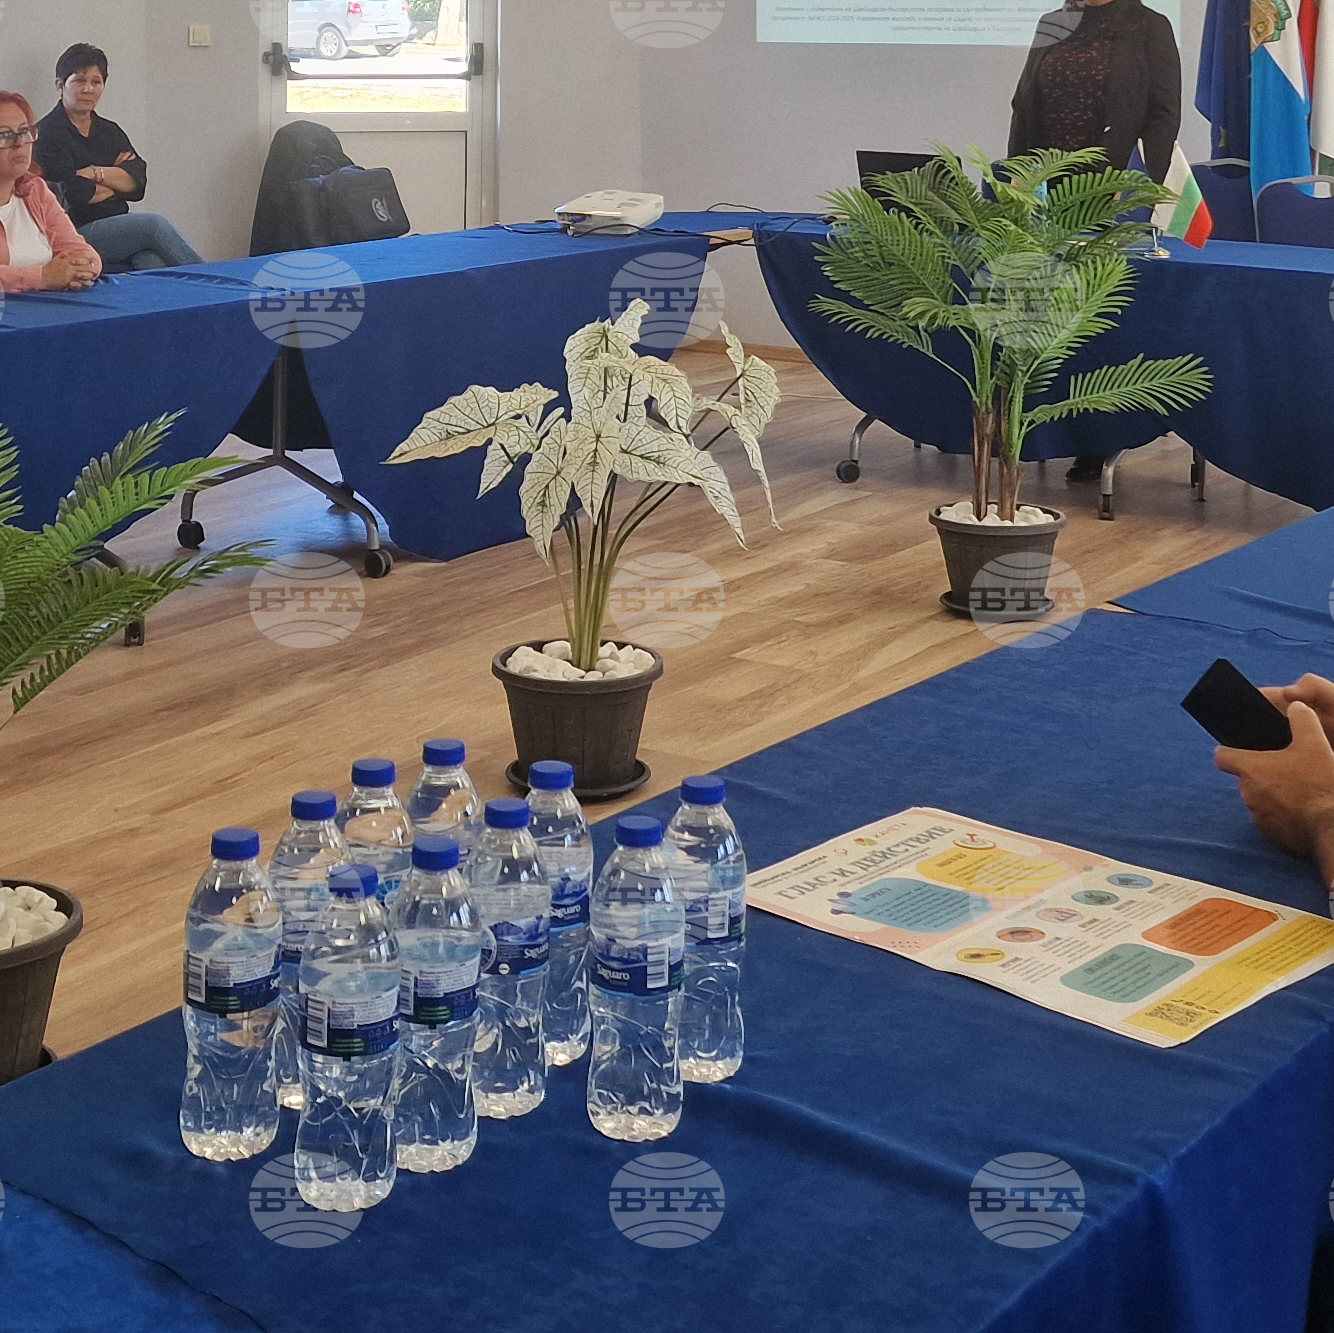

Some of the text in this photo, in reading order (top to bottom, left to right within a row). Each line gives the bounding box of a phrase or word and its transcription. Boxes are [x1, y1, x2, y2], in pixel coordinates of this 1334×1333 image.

[774, 873, 835, 901] ГЛАС
[831, 865, 857, 881] И
[850, 825, 955, 872] ДЕЙСТВИЕ
[596, 963, 630, 980] Saguaro
